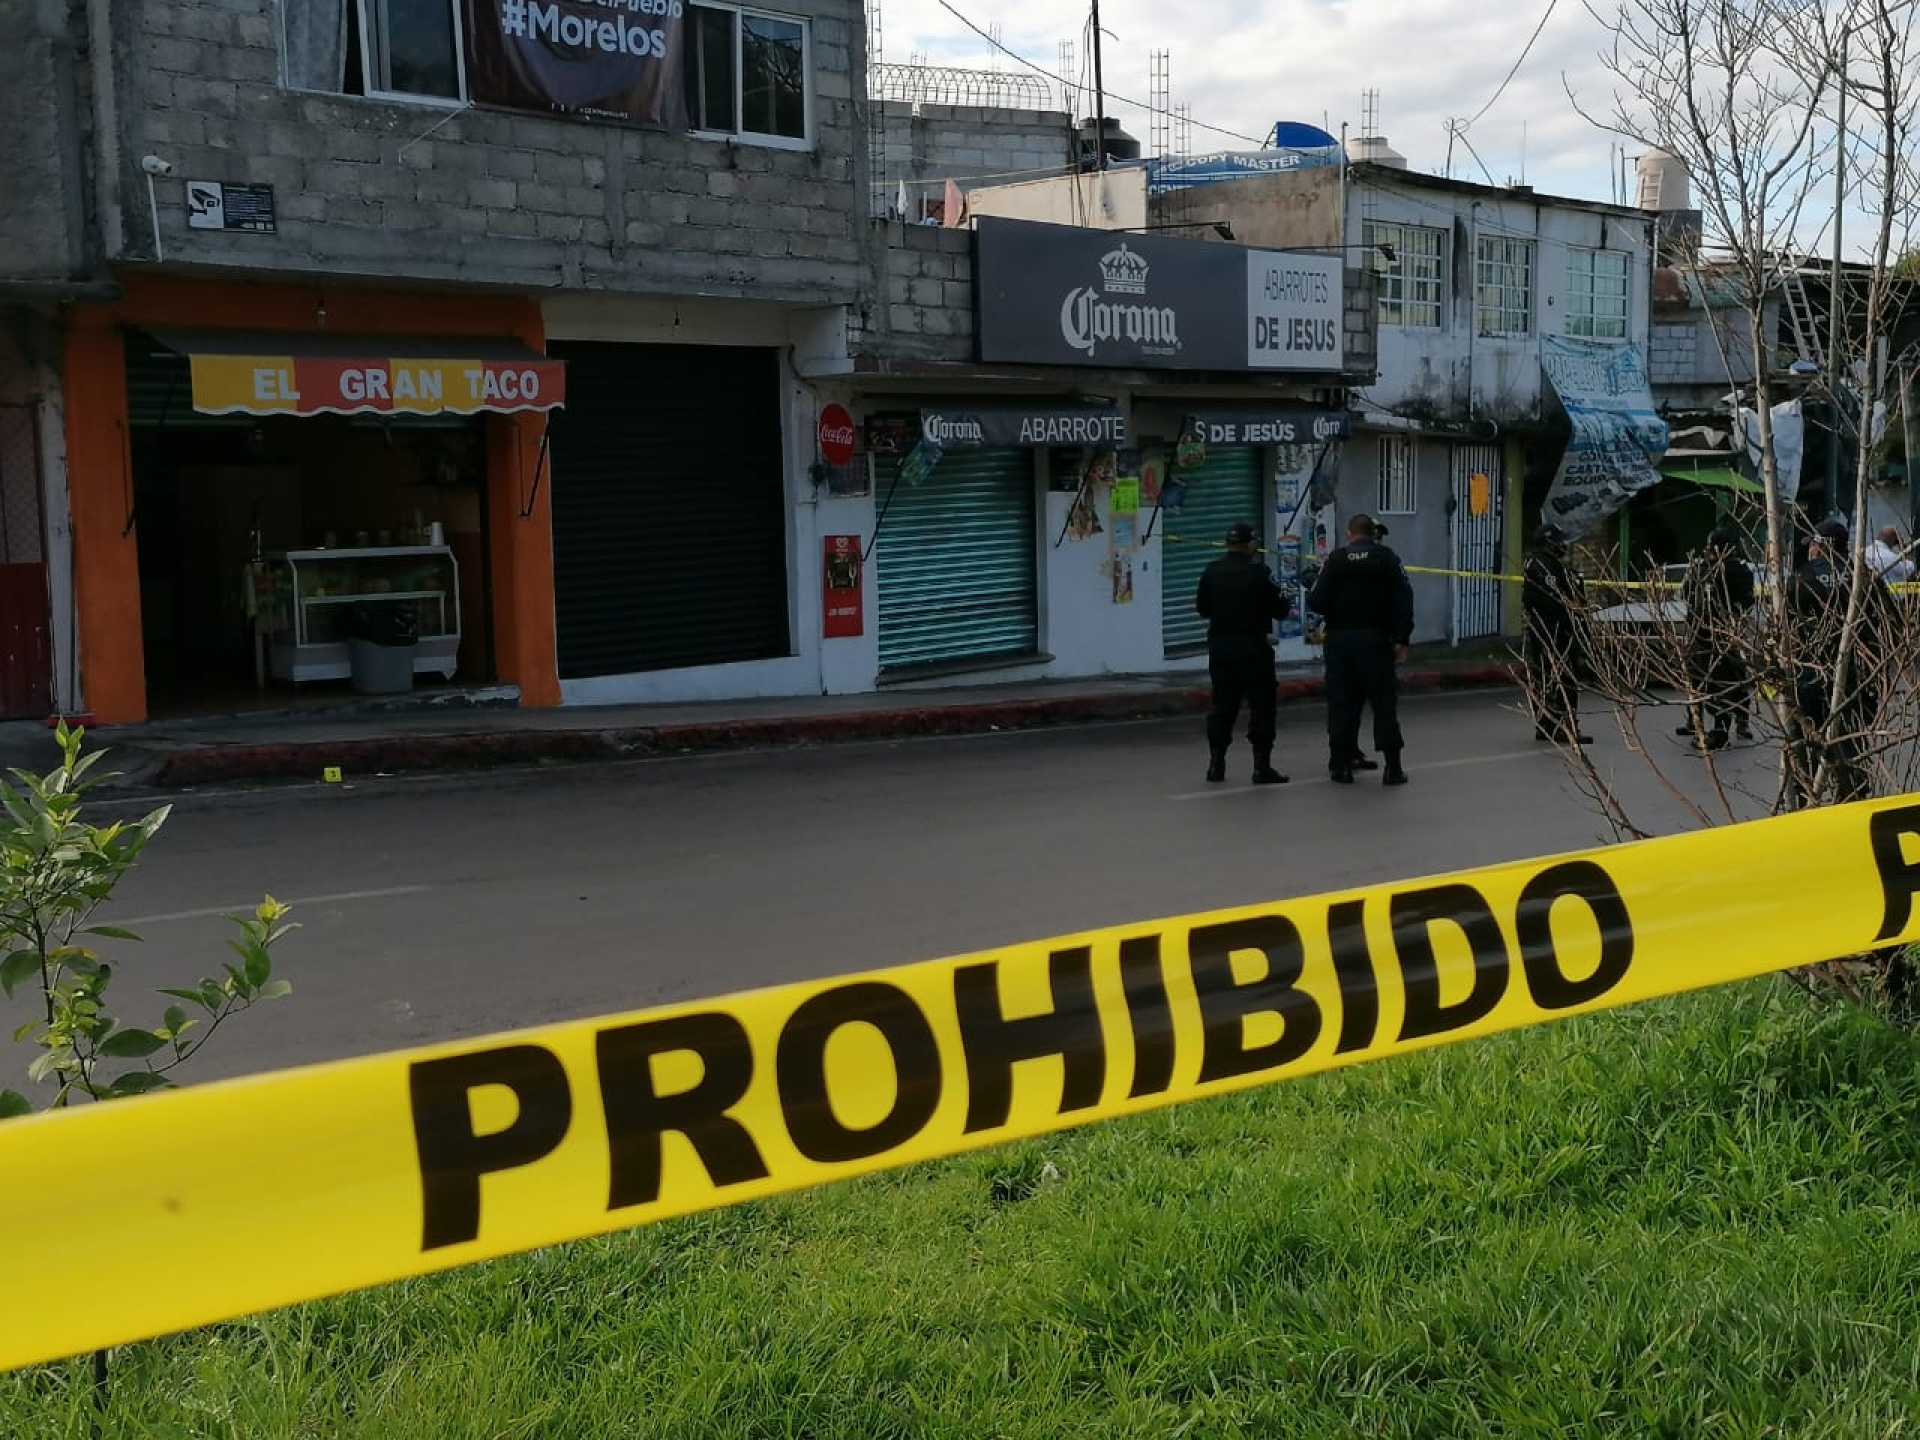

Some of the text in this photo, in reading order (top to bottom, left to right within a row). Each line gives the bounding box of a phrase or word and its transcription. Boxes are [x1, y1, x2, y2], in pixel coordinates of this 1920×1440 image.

[502, 0, 667, 58] #Morelos
[1233, 155, 1300, 170] MASTER
[1265, 269, 1328, 304] ABARROTES
[1060, 286, 1178, 357] Corona
[1255, 316, 1336, 351] DE JESUS
[253, 369, 539, 401] EL GRAN TACO
[924, 414, 985, 446] Corona
[1019, 416, 1126, 442] ABARROTE
[1211, 424, 1237, 443] DE
[409, 861, 1634, 1251] PROHIBIDO
